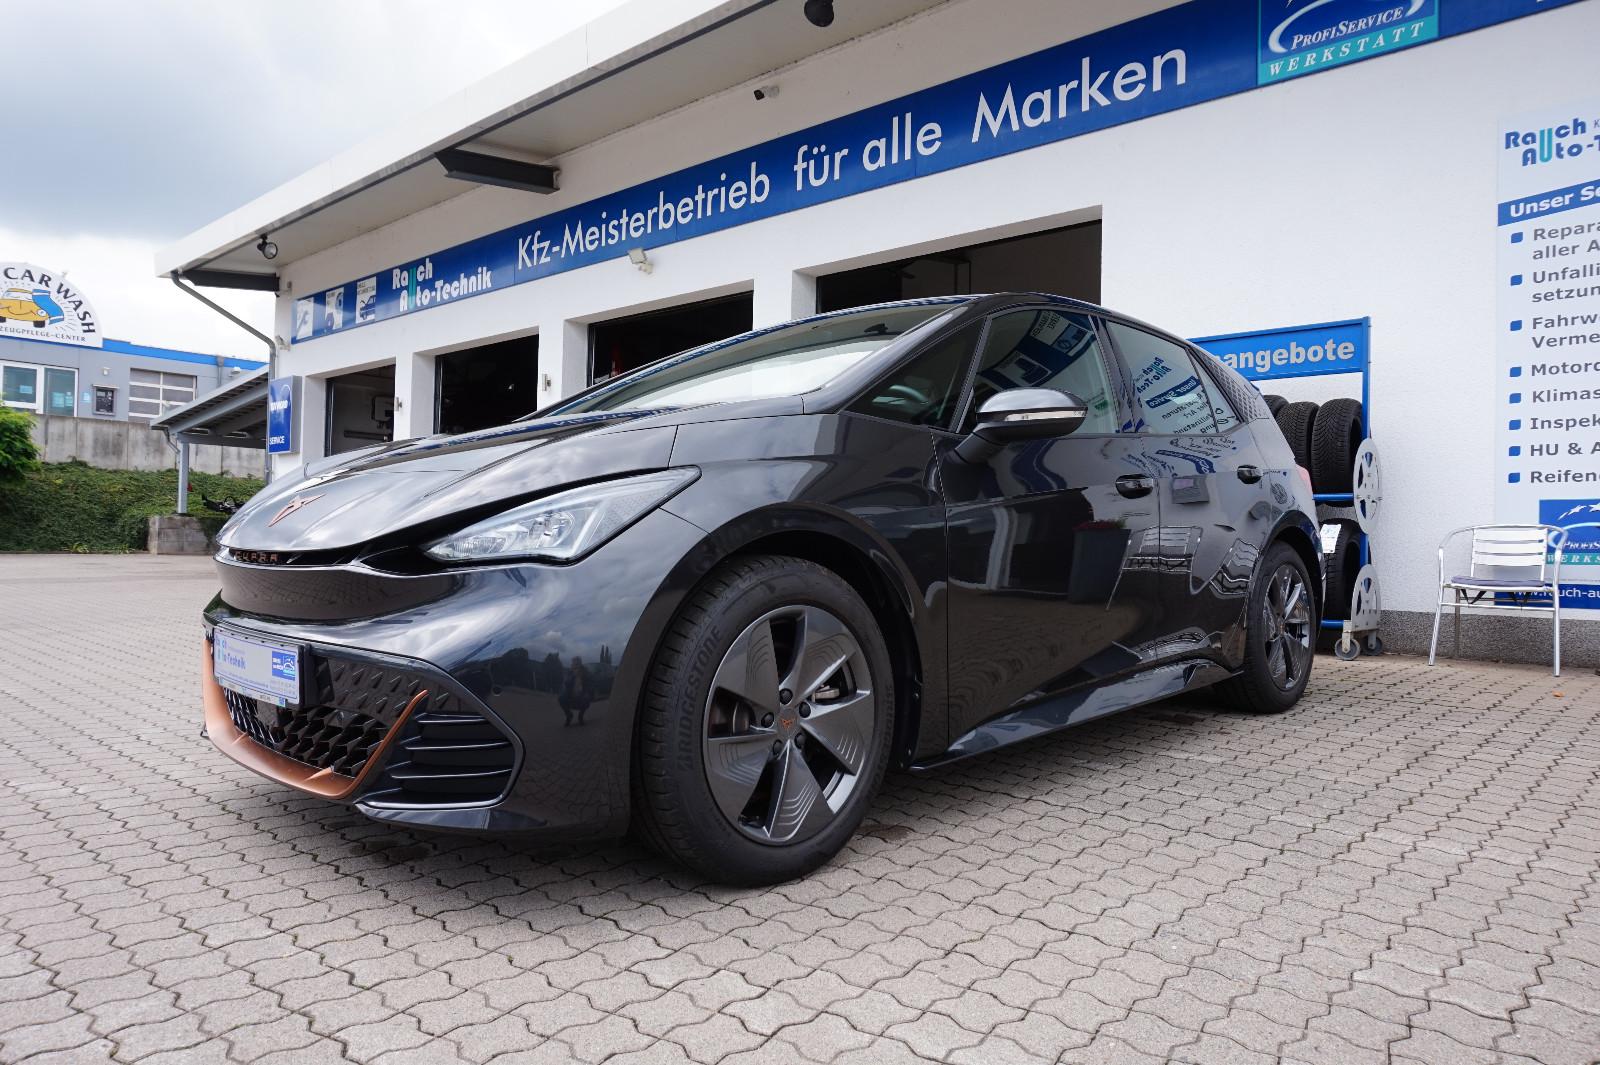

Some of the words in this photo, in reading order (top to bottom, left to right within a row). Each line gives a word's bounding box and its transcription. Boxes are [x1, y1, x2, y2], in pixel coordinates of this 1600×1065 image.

[1268, 22, 1424, 77] WERKSTATT
[1505, 117, 1587, 162] Rauch
[517, 161, 770, 270] Kfz-Meisterbetrieb
[793, 144, 849, 191] für
[862, 112, 942, 172] alle
[971, 48, 1187, 143] Marken
[1510, 192, 1574, 217] Unser
[1532, 243, 1580, 260] aller
[392, 257, 433, 291] Rauch
[1533, 262, 1600, 284] Unfalli
[3, 266, 52, 288] CAR
[56, 282, 96, 334] WASH
[399, 266, 492, 312] Auto-Technik
[1531, 332, 1600, 349] Verme
[1211, 338, 1355, 373] angebote
[1532, 388, 1600, 404] Klimas
[1530, 413, 1600, 432] Inspek
[1530, 443, 1559, 457] HU
[1567, 442, 1583, 456] &
[1530, 469, 1600, 484] Reifen
